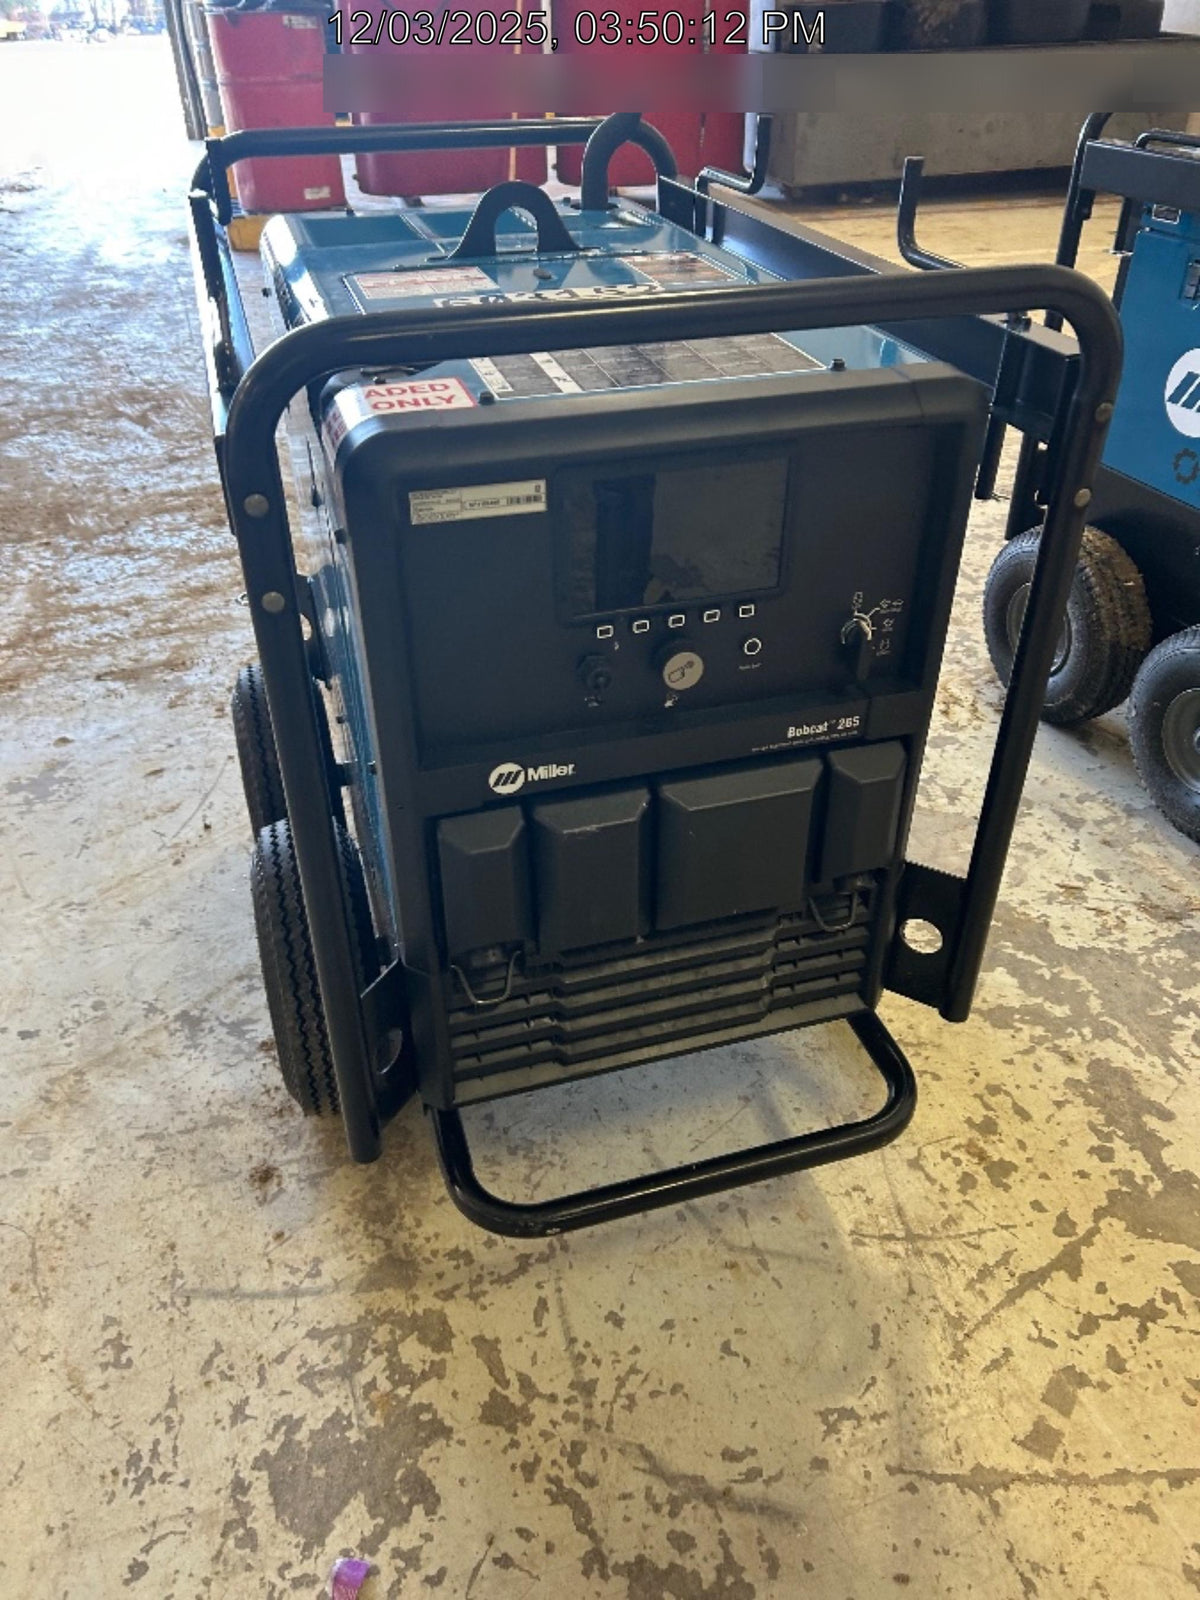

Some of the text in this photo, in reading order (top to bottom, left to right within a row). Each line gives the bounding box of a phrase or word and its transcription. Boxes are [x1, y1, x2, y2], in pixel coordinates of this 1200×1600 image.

[371, 394, 456, 410] ONLY
[786, 721, 828, 738] Bobcat
[526, 763, 576, 782] Miller
